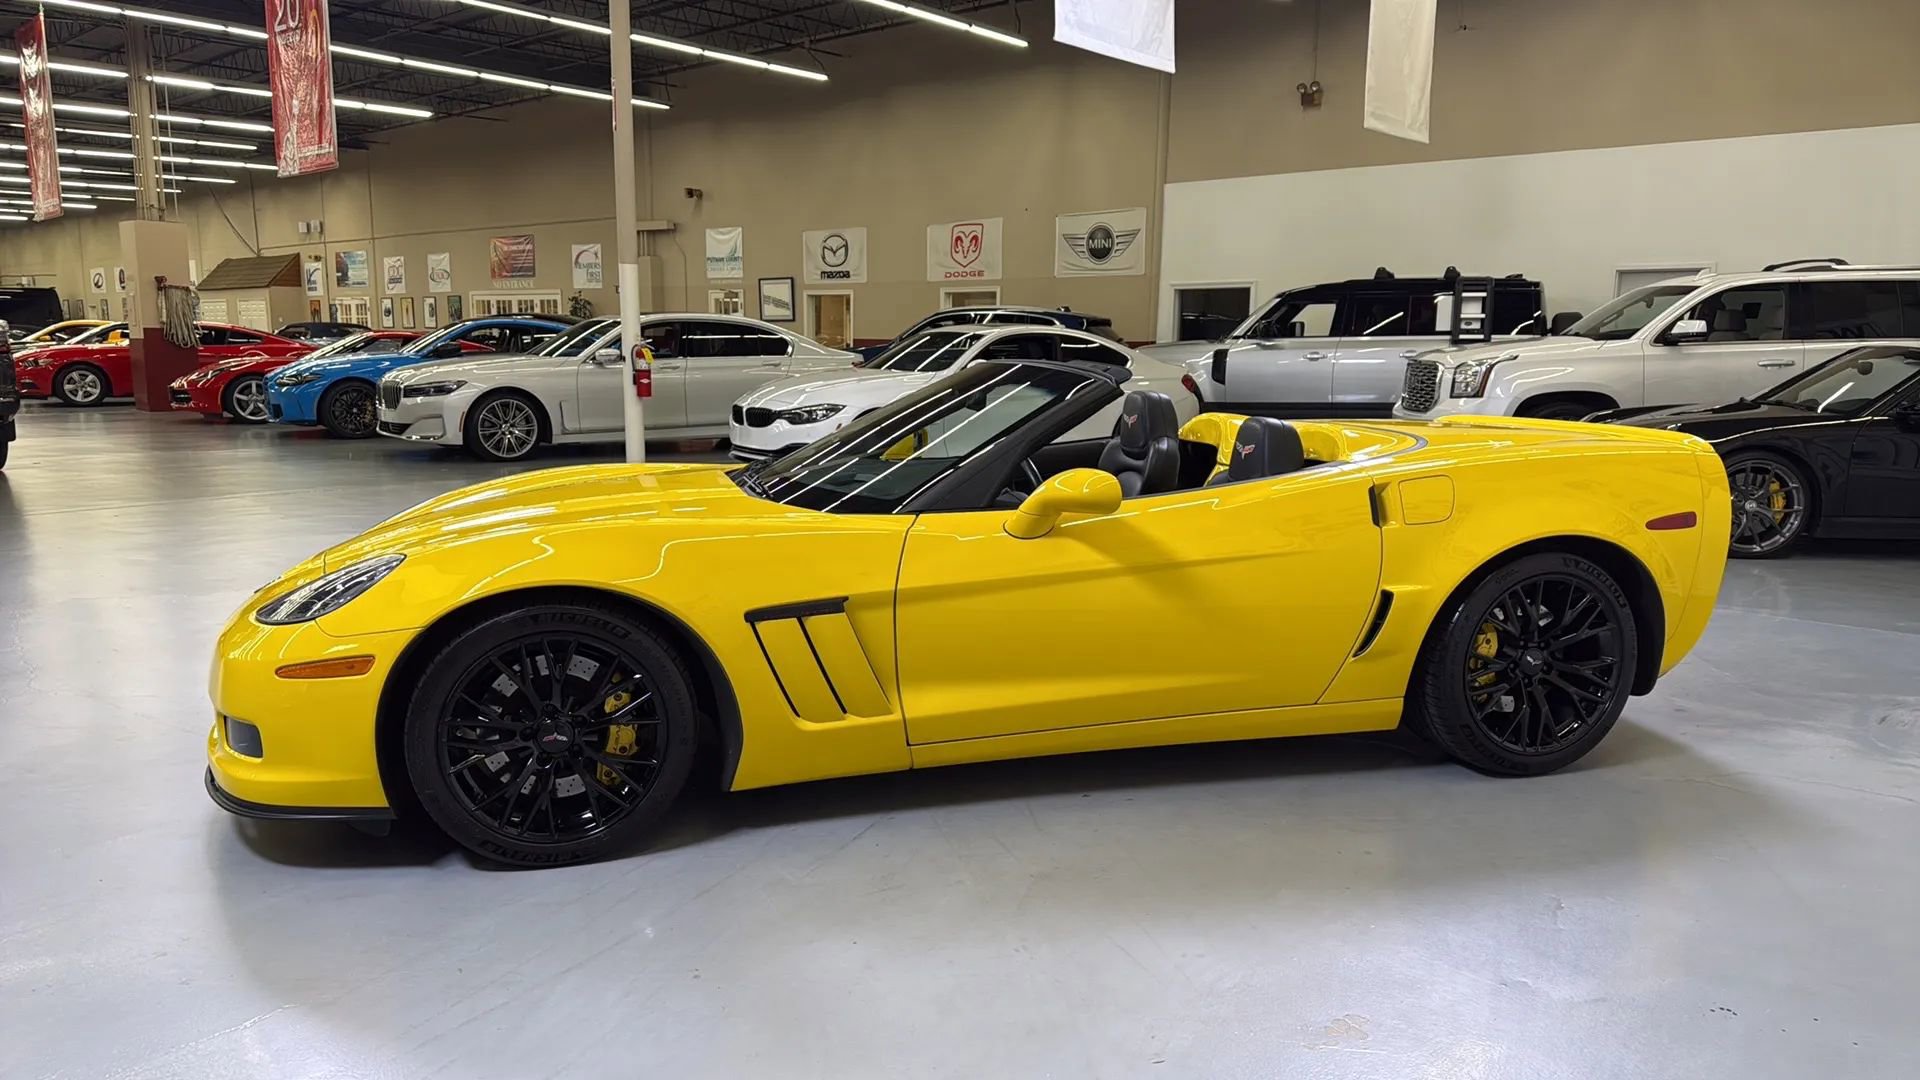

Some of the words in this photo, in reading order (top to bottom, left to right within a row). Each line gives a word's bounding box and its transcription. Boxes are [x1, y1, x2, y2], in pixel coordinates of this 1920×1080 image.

[1089, 238, 1111, 249] MINI
[944, 270, 985, 279] DODGE
[1577, 556, 1627, 609] MICHELIN
